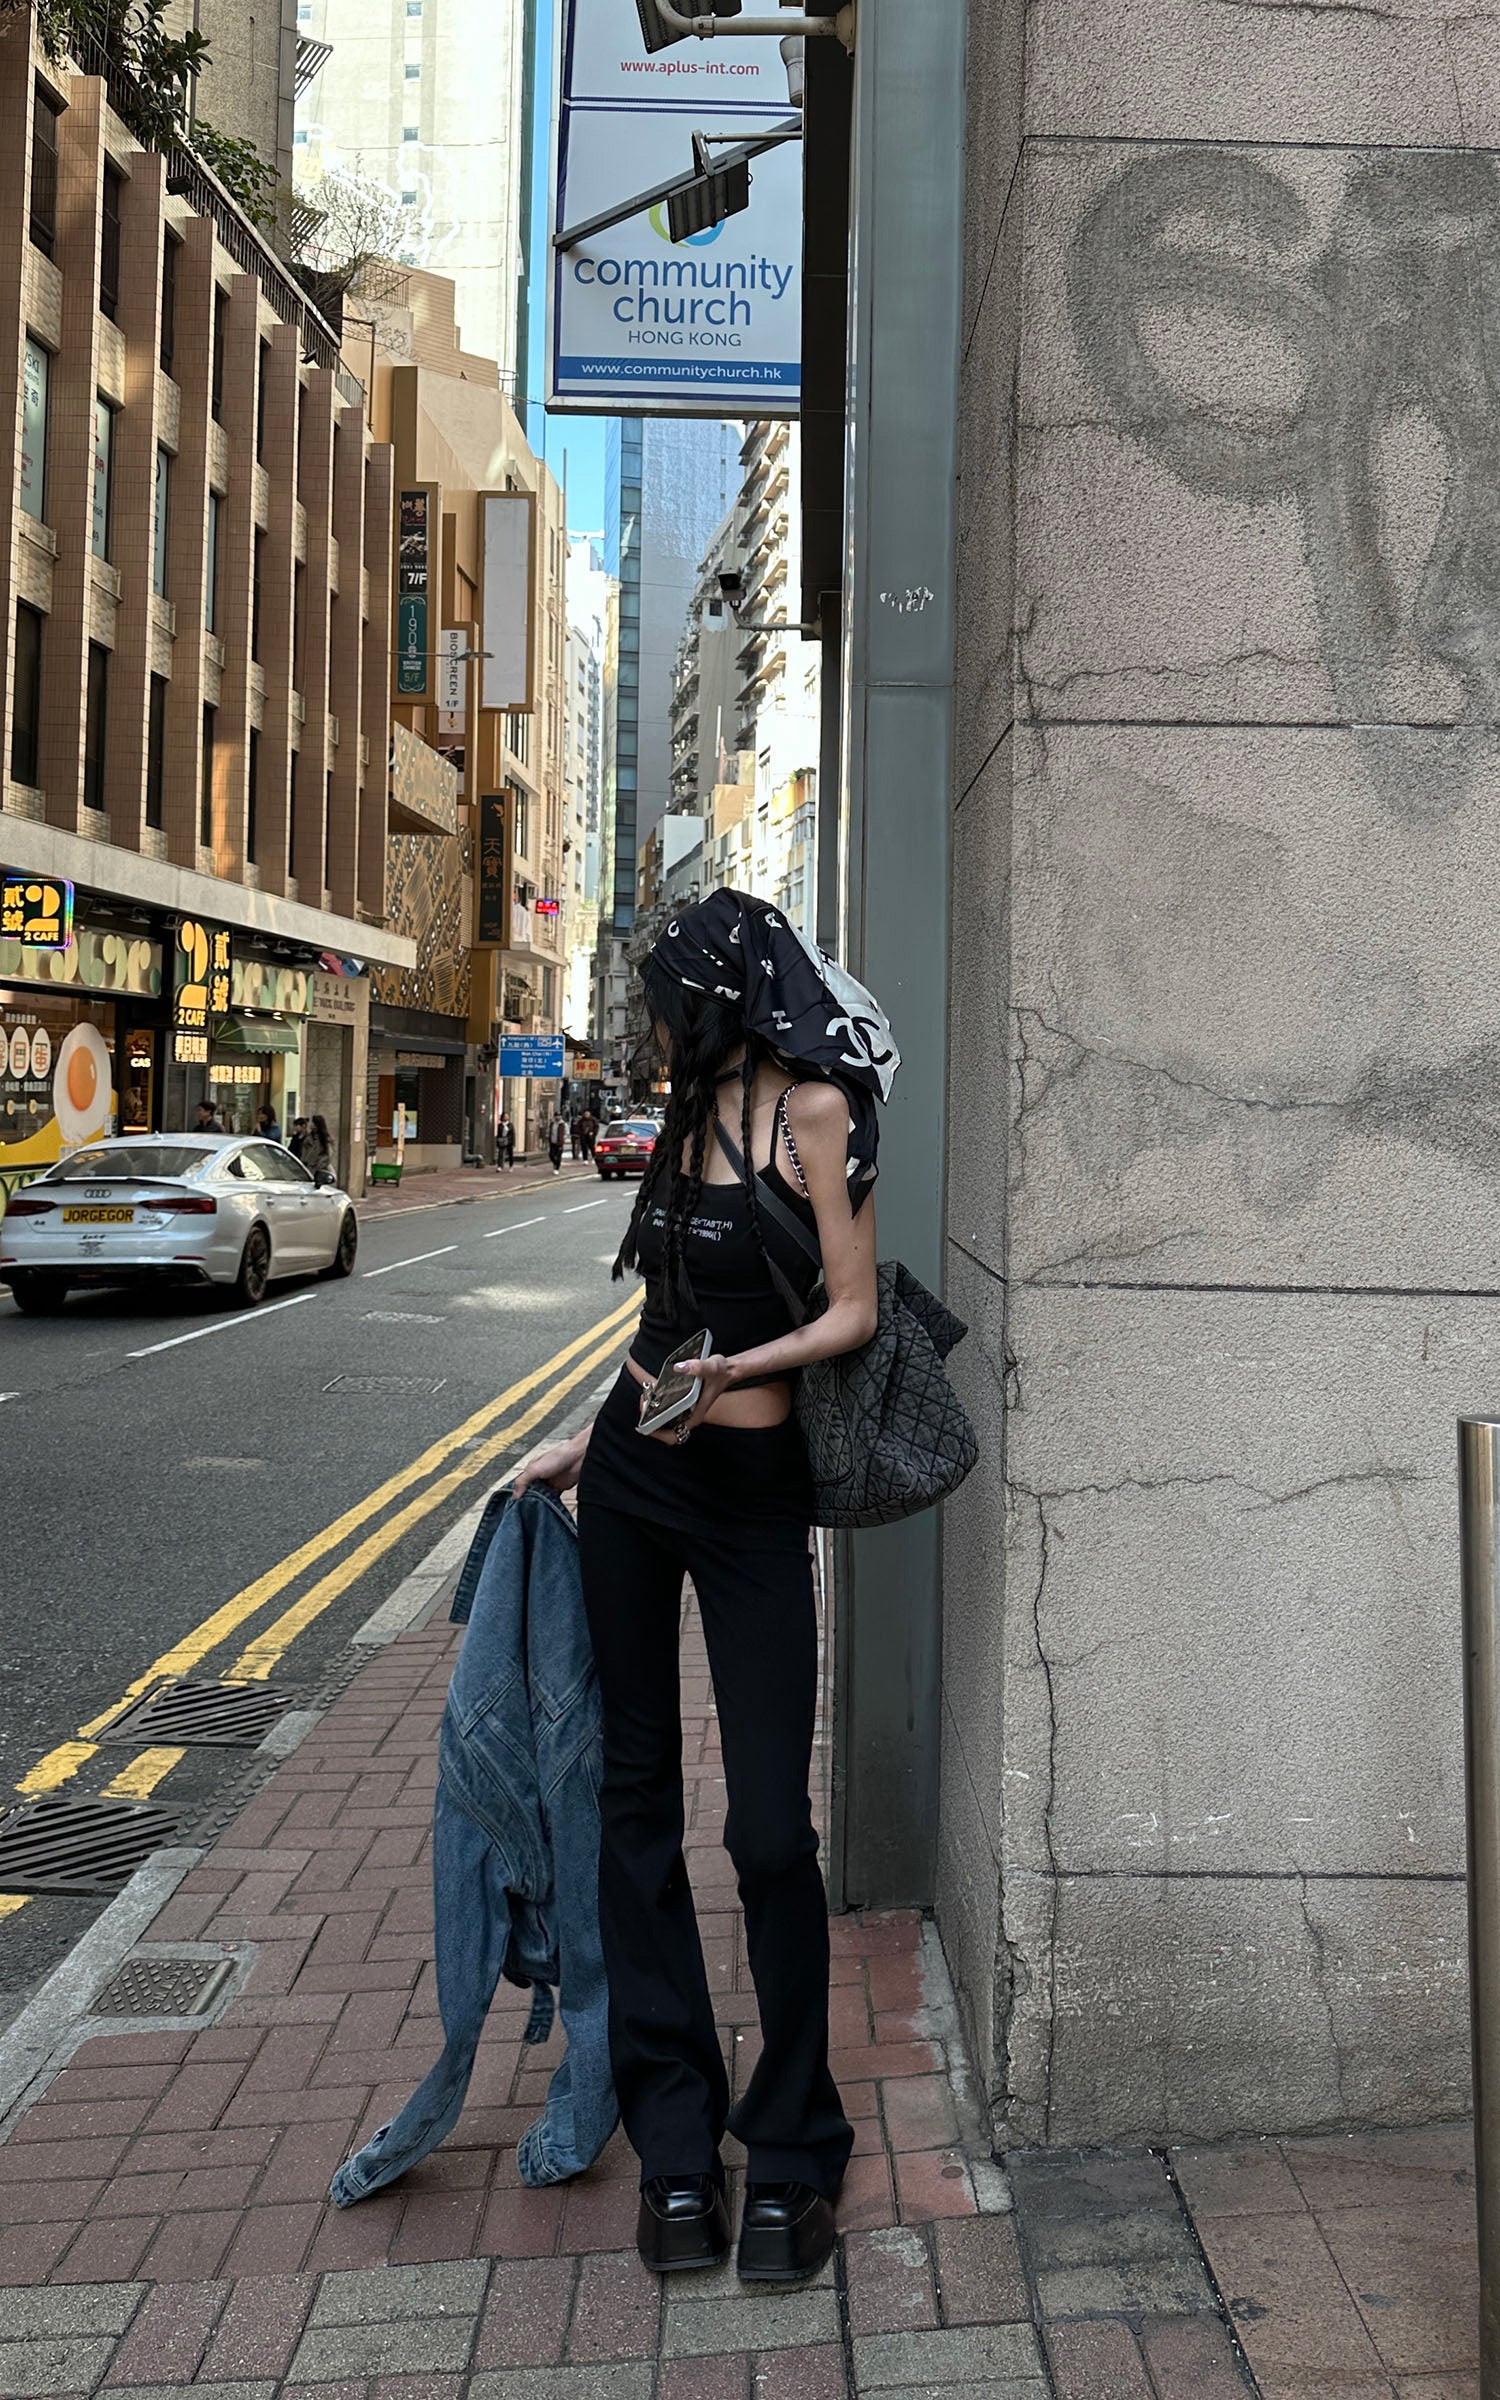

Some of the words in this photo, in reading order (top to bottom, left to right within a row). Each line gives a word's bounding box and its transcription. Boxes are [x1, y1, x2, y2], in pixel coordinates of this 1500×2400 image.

[620, 60, 760, 76] www.aplus-int.com
[573, 254, 793, 300] community
[612, 288, 752, 327] church
[628, 330, 684, 345] HONG
[688, 332, 742, 347] KONG
[581, 362, 783, 379] www.communitychurch.hk
[407, 572, 428, 585] 7/F
[24, 932, 31, 940] 2
[33, 932, 59, 941] CAFE
[178, 1008, 185, 1024] 2
[186, 1010, 206, 1027] CAFE
[62, 1208, 135, 1223] JORGEGOR
